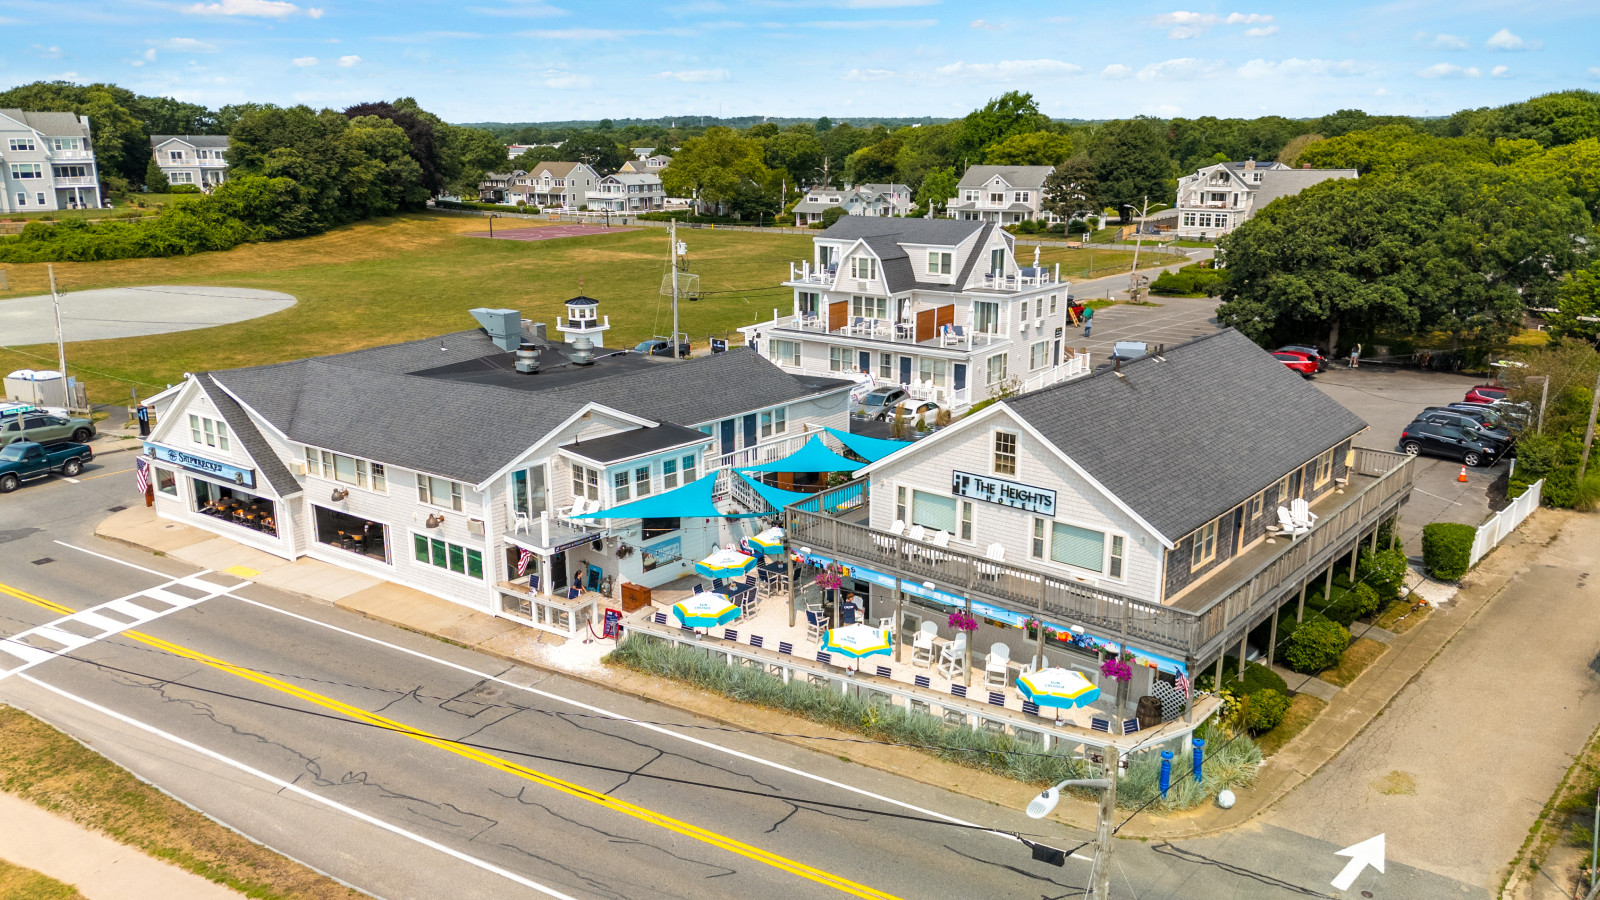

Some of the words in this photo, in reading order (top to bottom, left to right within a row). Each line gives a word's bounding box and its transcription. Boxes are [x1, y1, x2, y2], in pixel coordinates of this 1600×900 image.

[973, 478, 996, 494] THE
[1000, 483, 1052, 507] HEIGHTS
[986, 494, 1037, 512] HOTEL
